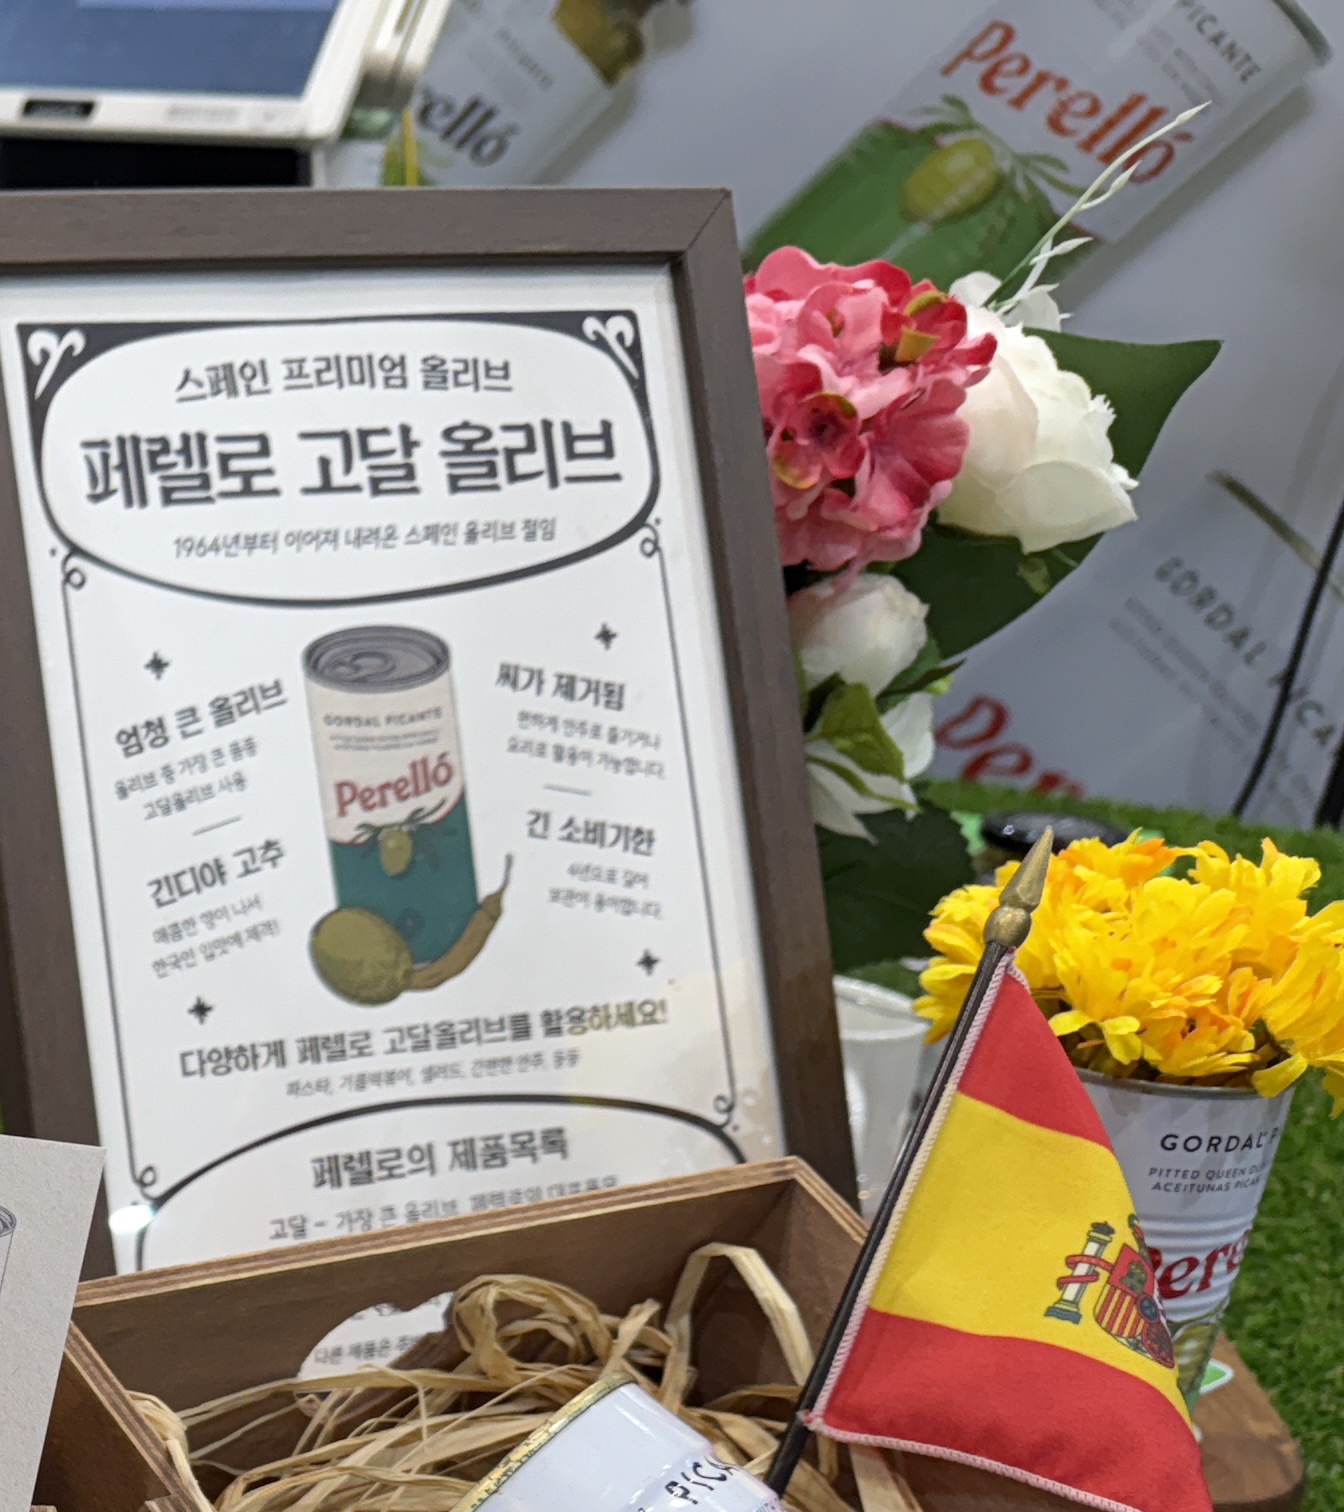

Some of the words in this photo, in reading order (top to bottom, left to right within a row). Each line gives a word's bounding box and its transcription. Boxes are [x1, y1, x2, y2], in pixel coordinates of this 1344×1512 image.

[939, 19, 1196, 185] Perelló
[175, 360, 272, 402] 스페인
[282, 355, 409, 391] 프리미엄
[418, 354, 514, 392] 올리브
[80, 431, 282, 509] 페렐로
[297, 424, 421, 498] 고달
[439, 418, 622, 496] 올리브
[174, 530, 279, 559] 1964년부터
[405, 522, 458, 546] 스페인
[464, 521, 517, 544] 올리브
[1154, 555, 1272, 669] GORDAL
[115, 714, 169, 758] 엄청
[175, 706, 204, 740] 큰
[208, 678, 289, 729] 올리브
[495, 662, 545, 697] 씨가
[551, 673, 625, 712] 제거됨
[526, 810, 550, 839] 긴
[557, 815, 656, 856] 소비기한
[147, 857, 228, 910] 긴디야
[232, 838, 286, 879] 고추
[179, 1038, 287, 1079] 다양하게
[295, 1029, 374, 1064] 페렐로
[382, 1010, 533, 1055] 고달올리브를
[539, 998, 669, 1039] 활용하세요!
[311, 1138, 438, 1193] 페렐로의
[447, 1126, 569, 1173] 제품목록
[1160, 1132, 1266, 1154] GORDAL
